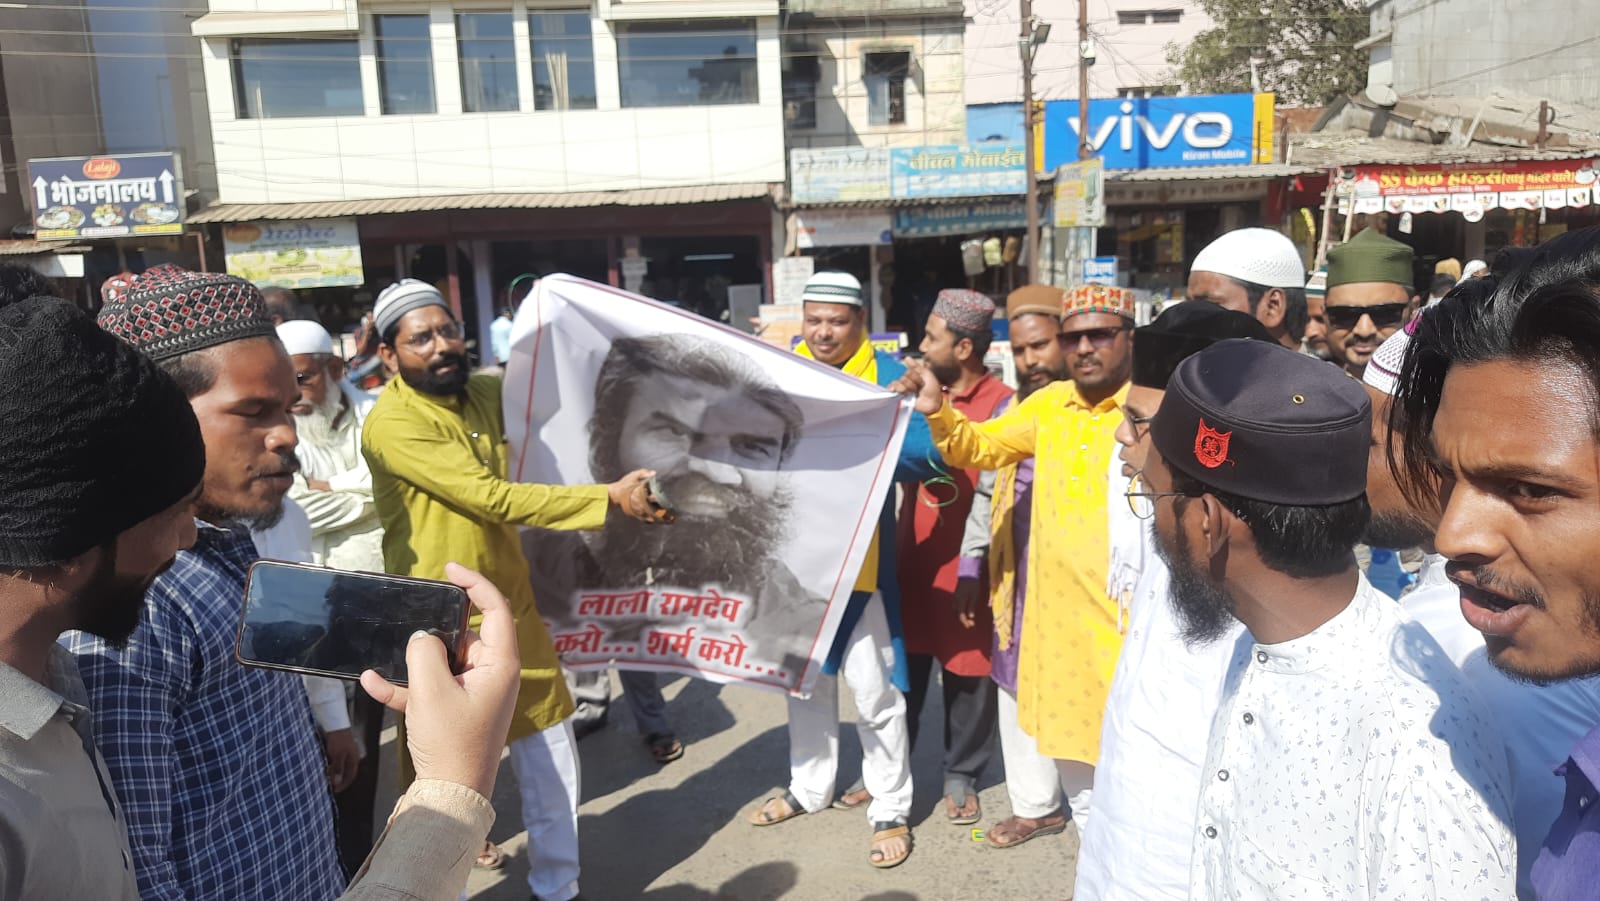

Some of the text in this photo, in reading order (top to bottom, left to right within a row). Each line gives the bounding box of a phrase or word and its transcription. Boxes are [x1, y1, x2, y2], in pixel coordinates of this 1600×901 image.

[1067, 101, 1233, 151] vivo
[51, 174, 157, 206] भोजनालय
[660, 588, 743, 623] रामदेव
[646, 626, 695, 658] शर्म
